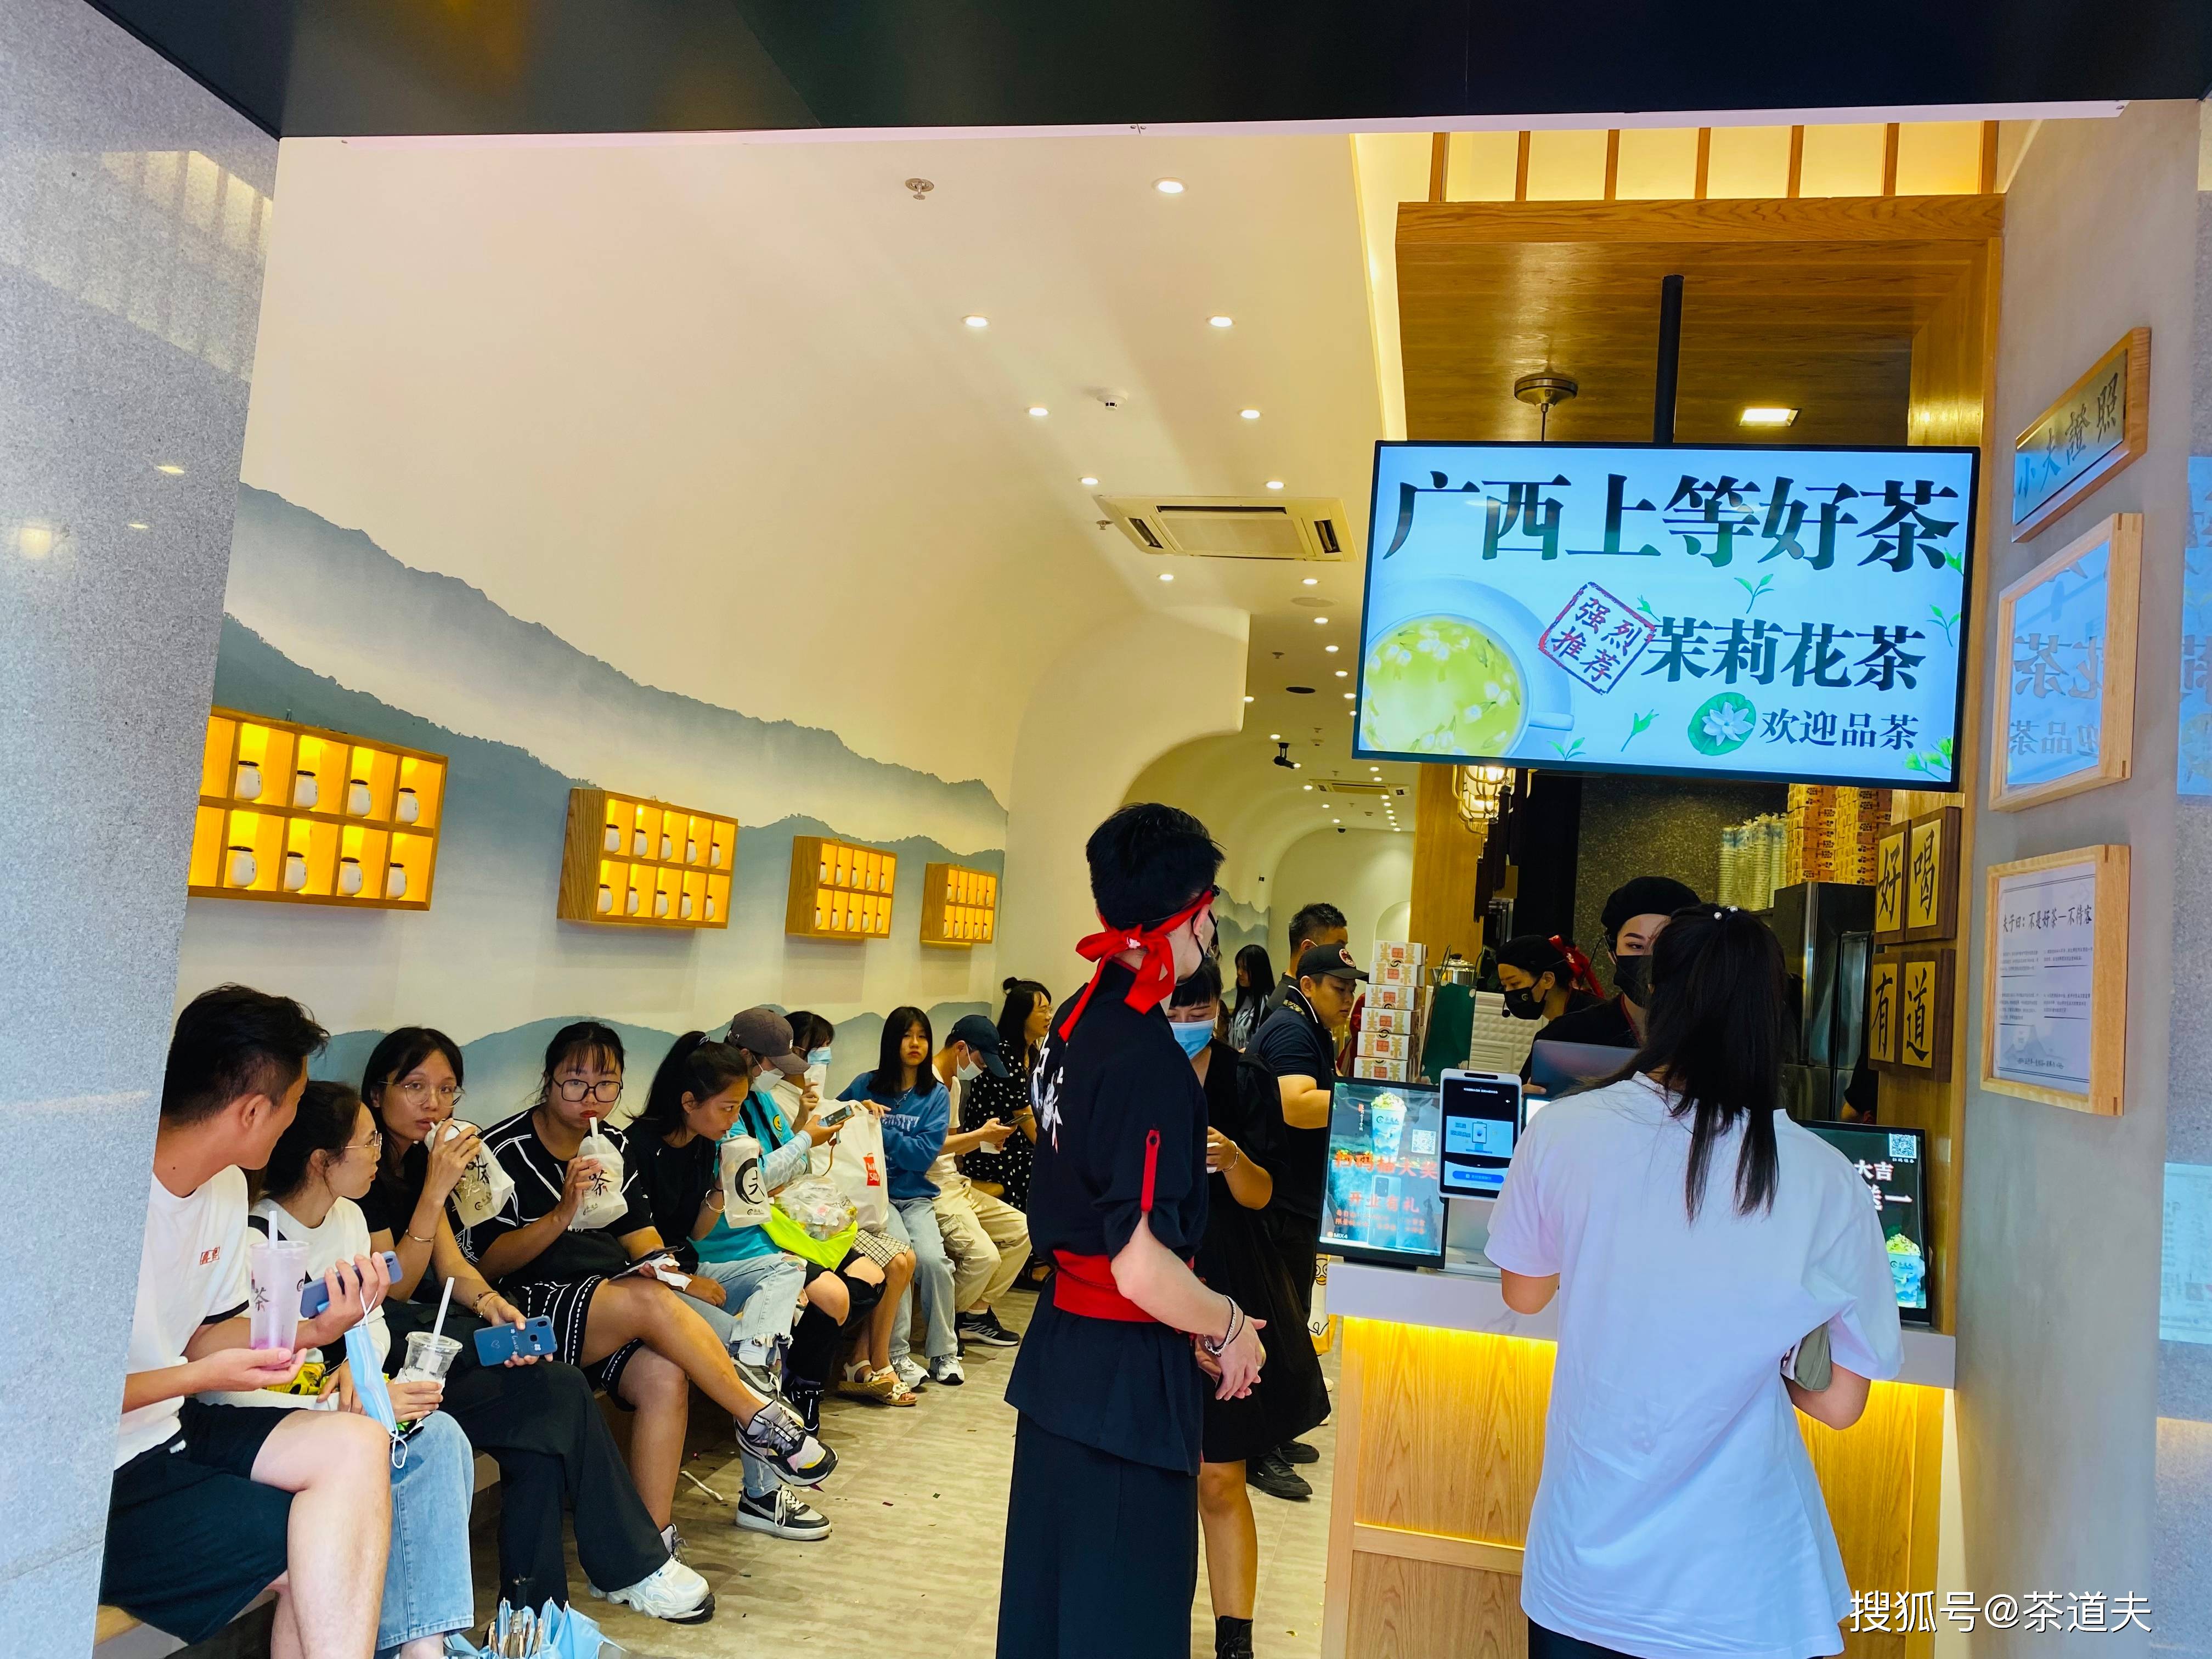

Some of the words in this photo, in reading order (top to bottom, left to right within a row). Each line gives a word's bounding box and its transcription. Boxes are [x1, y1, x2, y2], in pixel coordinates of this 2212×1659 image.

[1383, 471, 1959, 572] 广西上等好茶
[1551, 625, 1621, 682] 推荐
[1575, 596, 1643, 657] 强烈
[1640, 616, 1926, 691] 茉莉花茶
[1759, 708, 1918, 751] 欢迎品茶
[1335, 1150, 1438, 1180] 扫码抽大奖
[1349, 1192, 1420, 1213] 开业有礼
